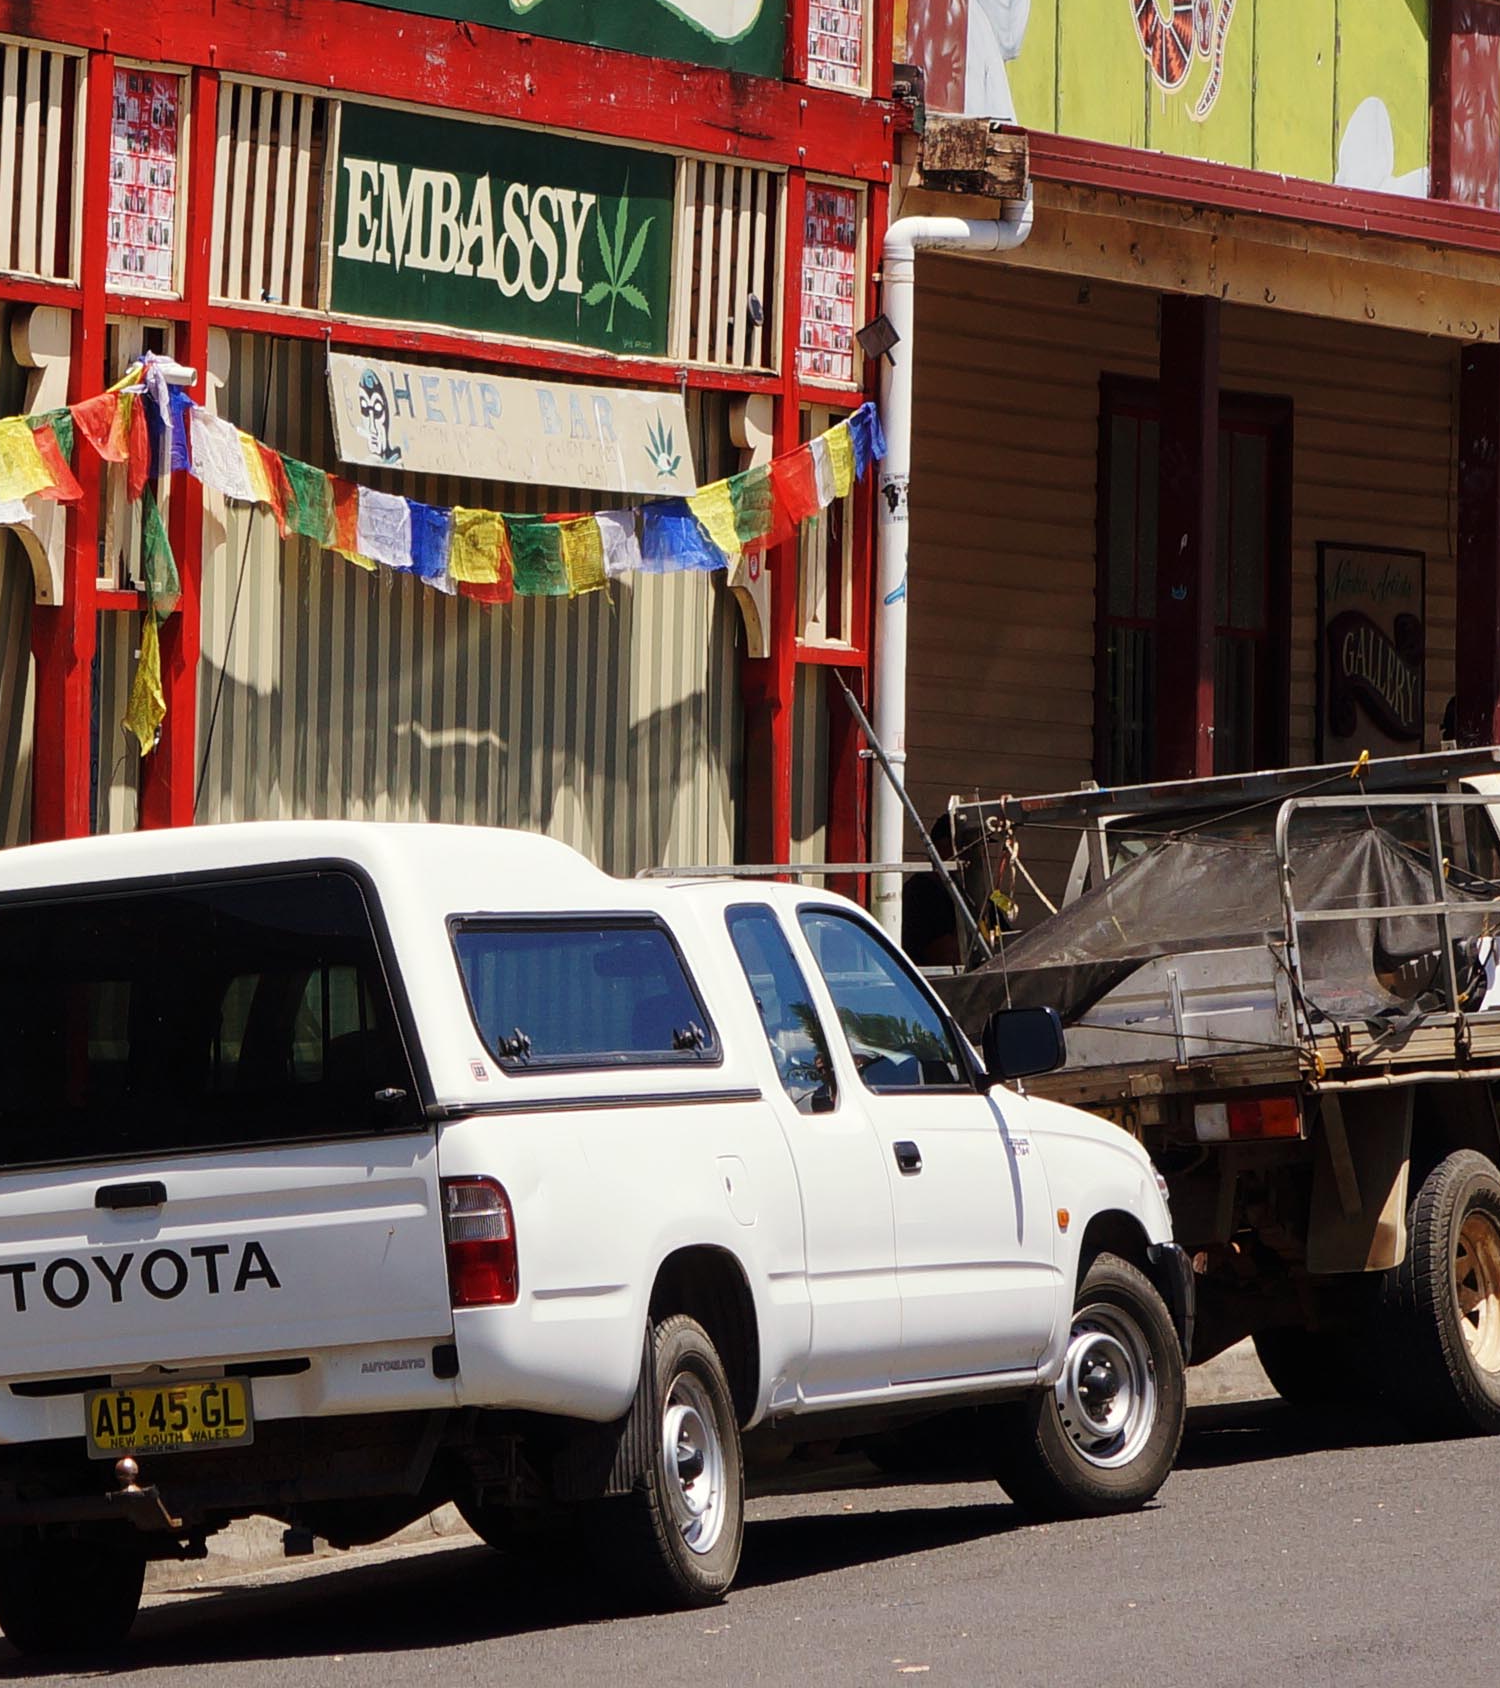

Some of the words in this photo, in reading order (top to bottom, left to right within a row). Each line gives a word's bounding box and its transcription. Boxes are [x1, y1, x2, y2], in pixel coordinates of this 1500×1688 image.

[337, 156, 597, 302] EMBASSY
[390, 371, 502, 430] HEMP
[535, 388, 620, 443] BAR
[1342, 626, 1417, 727] GALLERY
[110, 1434, 136, 1449] NEW
[143, 1431, 184, 1446] SOUTH
[191, 1428, 231, 1442] WALES
